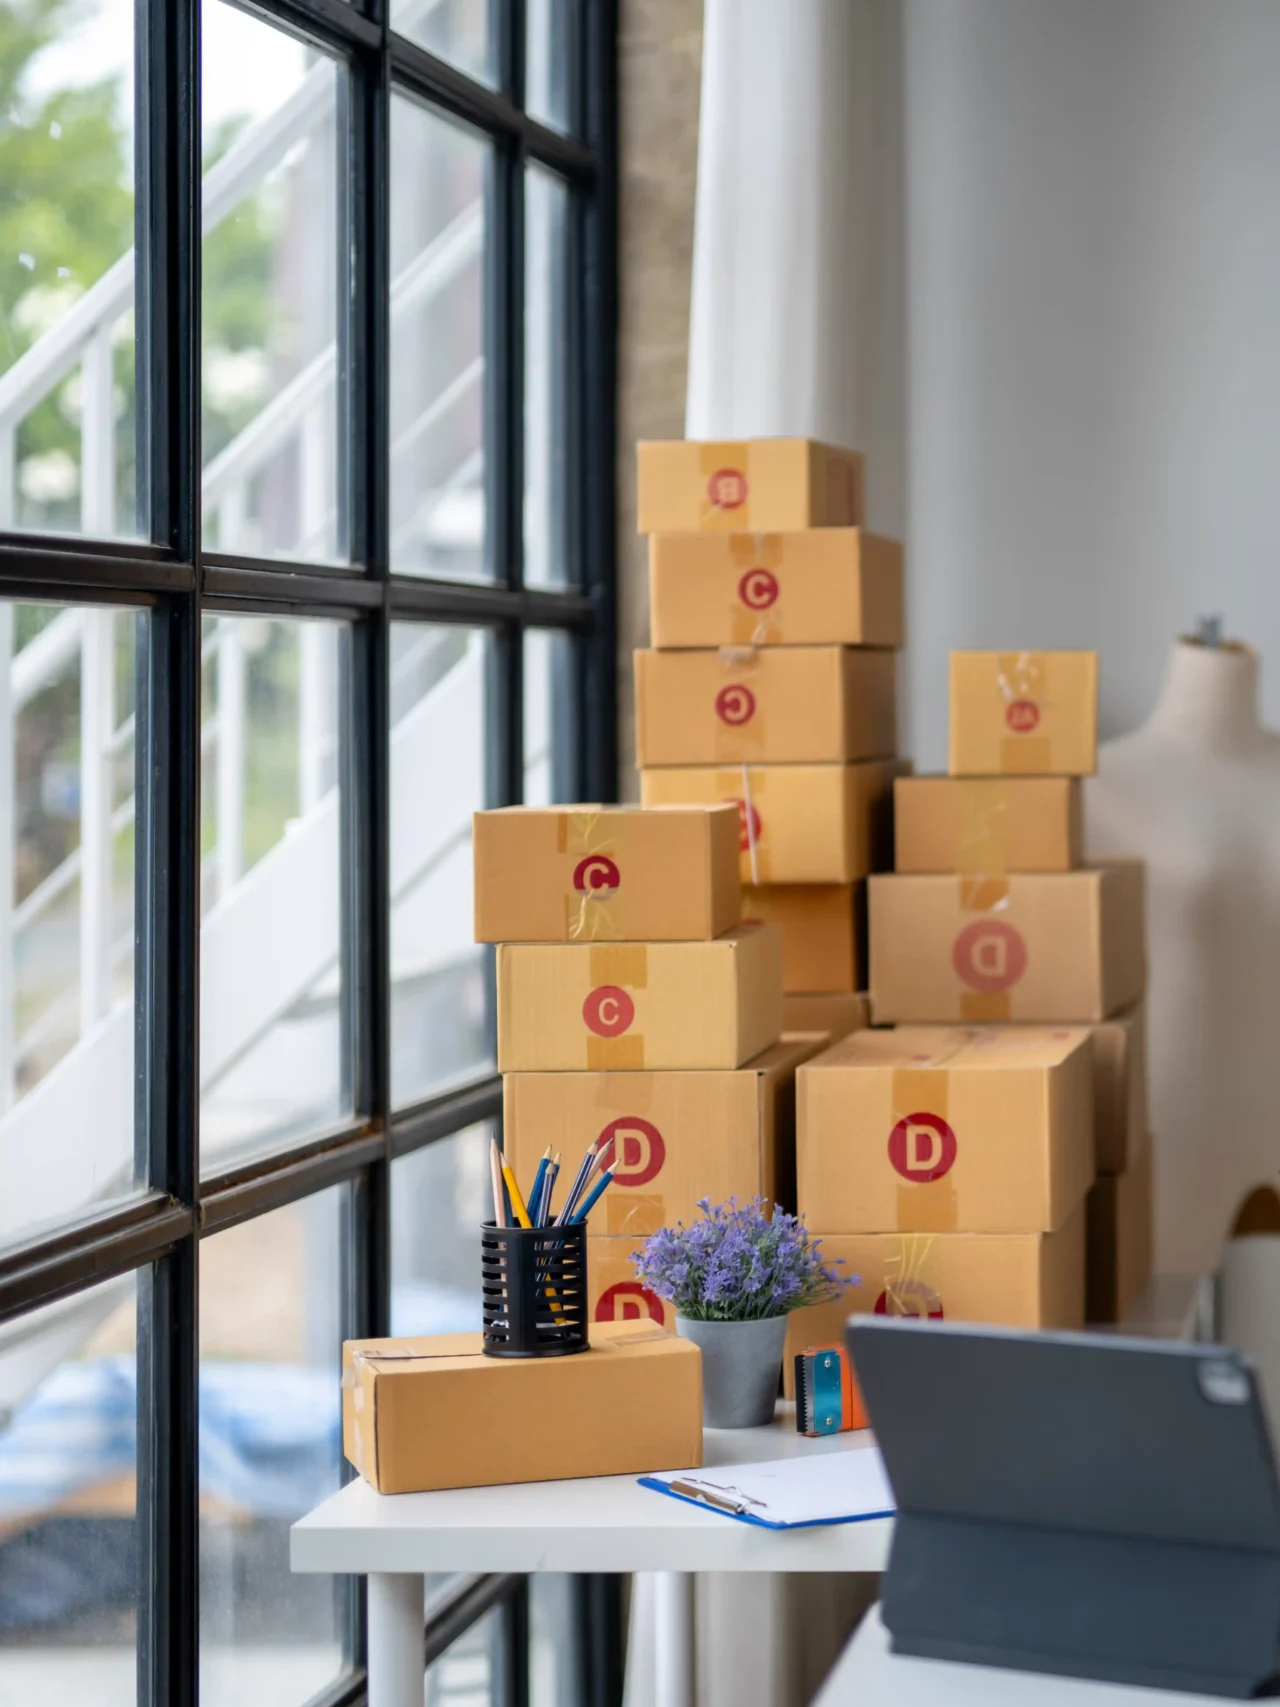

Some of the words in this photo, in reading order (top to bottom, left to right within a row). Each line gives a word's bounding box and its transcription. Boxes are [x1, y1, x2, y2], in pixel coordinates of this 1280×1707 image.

[745, 573, 770, 605] C
[724, 690, 749, 721] C
[583, 862, 610, 897] C
[971, 935, 1006, 978] D
[598, 997, 619, 1025] C
[614, 1128, 651, 1175] D
[906, 1125, 942, 1171] D
